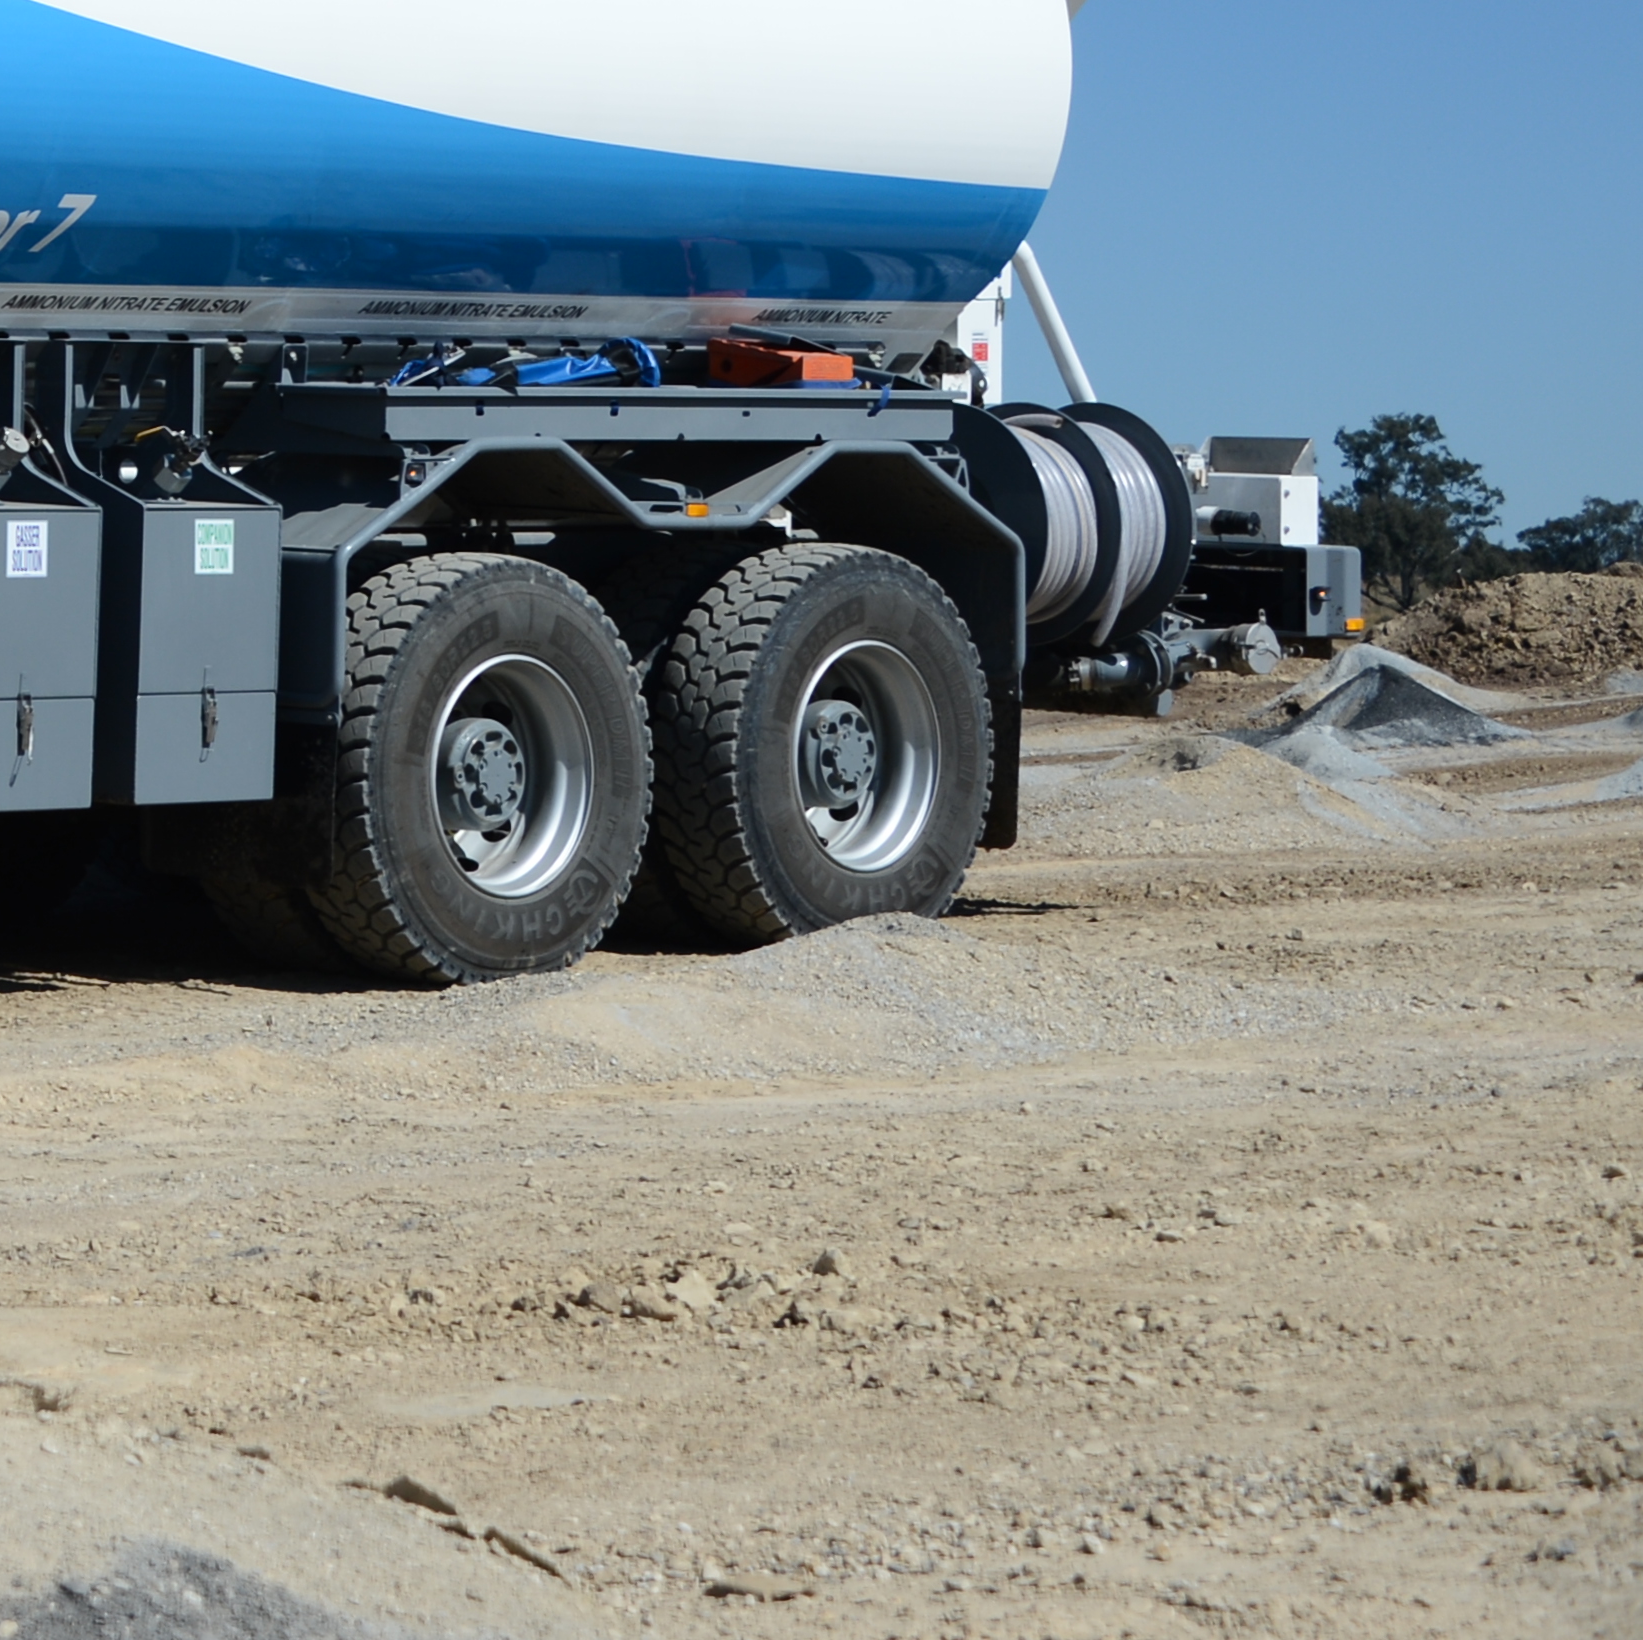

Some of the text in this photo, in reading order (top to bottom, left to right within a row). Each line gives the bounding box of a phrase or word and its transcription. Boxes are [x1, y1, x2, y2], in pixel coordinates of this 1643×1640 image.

[29, 194, 97, 253] 7
[1, 295, 252, 314] AMMONIUM NITRATE EMULSION
[358, 301, 589, 319] AMMONIUM NITRATE EMULSION
[751, 308, 893, 325] AMMONIUM NITRATE
